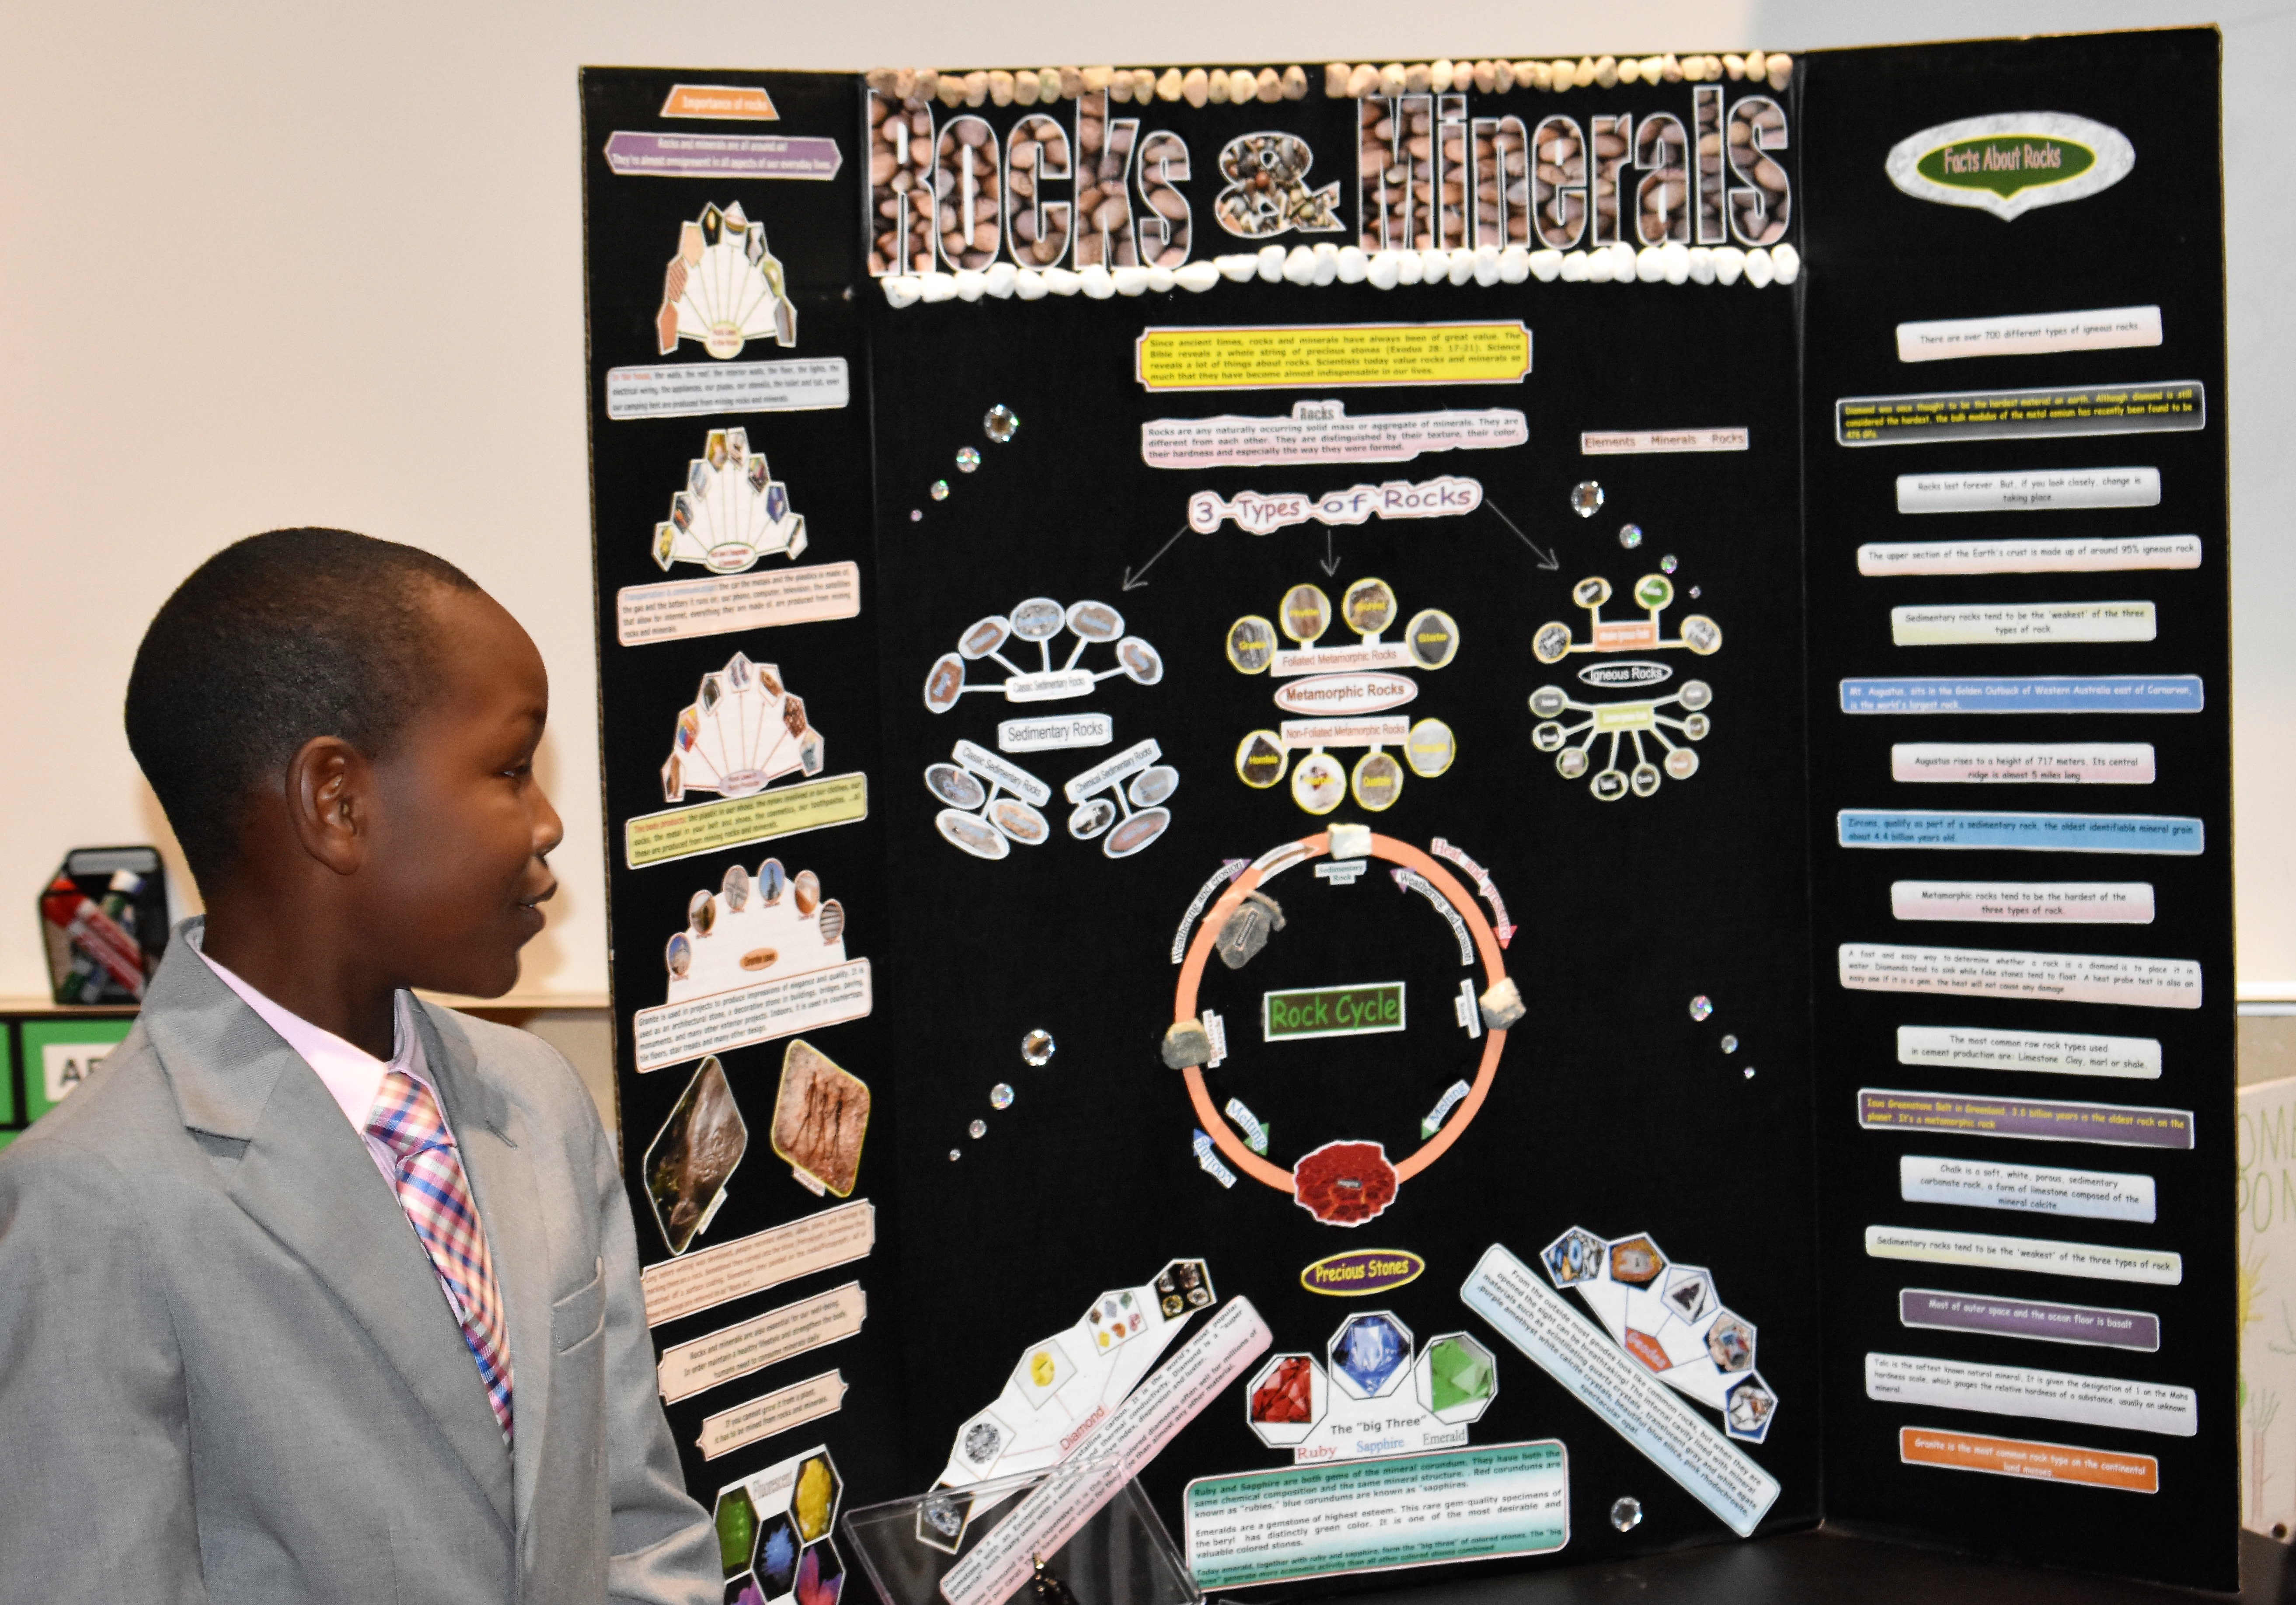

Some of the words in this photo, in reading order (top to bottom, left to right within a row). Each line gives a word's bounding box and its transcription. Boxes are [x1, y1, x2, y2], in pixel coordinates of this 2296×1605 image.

[1942, 147, 1980, 174] Facts
[1982, 145, 2022, 171] About
[2022, 141, 2061, 169] Rocks
[867, 85, 1192, 276] Rocks
[1214, 131, 1346, 238] &
[1358, 86, 1790, 253] Minerals
[1920, 335, 1944, 344] There
[1985, 331, 2000, 339] 700
[2003, 328, 2042, 338] different
[2045, 328, 2067, 338] types
[2070, 324, 2079, 334] of
[2083, 324, 2112, 335] igneous
[1300, 407, 1334, 420] Rocks
[1148, 428, 1174, 436] Rocks
[1215, 426, 1256, 434] naturally
[1259, 425, 1302, 433] occurring
[1371, 421, 1417, 431] aggregate
[1433, 419, 1474, 427] minerals.
[1479, 418, 1500, 426] They
[1148, 438, 1188, 447] different
[1217, 437, 1239, 445] each
[1275, 436, 1296, 444] They
[1320, 433, 1382, 443] distinguished
[1386, 432, 1397, 441] by
[1585, 436, 1635, 448] Elements
[1651, 434, 1696, 445] Minerals
[1712, 432, 1744, 444] Rocks
[1148, 450, 1170, 458] their
[1172, 449, 1214, 457] hardness
[1216, 448, 1233, 457] and
[1235, 447, 1280, 457] especially
[1282, 446, 1298, 454] the
[1321, 445, 1341, 454] they
[1196, 501, 1213, 523] 3
[1239, 500, 1300, 524] Types
[1324, 493, 1366, 513] of
[1385, 486, 1470, 508] Rocks
[1282, 655, 1315, 667] Foliated
[1317, 651, 1369, 664] Metamorphic
[1371, 649, 1397, 660] Rocks
[1013, 682, 1033, 693] Classic
[1034, 678, 1067, 691] Sedimentary
[1068, 677, 1085, 686] Rocks
[1590, 669, 1629, 681] Igneous
[1632, 667, 1662, 679] Rocks
[1286, 686, 1363, 701] Metamorphic
[1367, 683, 1404, 696] Rocks
[1008, 724, 1070, 742] Sedimentary
[1073, 721, 1103, 736] Rocks
[1286, 727, 1332, 739] Non-Foliated
[1335, 725, 1380, 736] Metamorphic
[1382, 723, 1405, 734] Rocks
[1075, 774, 1101, 793] Chemical
[1102, 758, 1134, 779] Sedimentary
[1134, 747, 1152, 761] Rocks
[1319, 864, 1362, 874] Sedimentary
[1434, 839, 1462, 861] Heat
[1465, 861, 1488, 880] and
[1482, 883, 1510, 936] pressure
[1921, 890, 1972, 901] Metamorphic
[1975, 892, 1997, 900] rocks
[2000, 892, 2019, 900] tend
[2047, 892, 2061, 901] the
[2064, 892, 2096, 901] hardest
[2099, 892, 2108, 901] of
[2112, 892, 2126, 901] the
[1171, 903, 1200, 962] Weathering
[1197, 884, 1212, 902] and
[1212, 860, 1243, 885] erosion
[1400, 872, 1446, 909] Weathering
[1445, 907, 1461, 924] and
[1456, 925, 1471, 961] erosion
[1981, 905, 2003, 914] three
[2007, 906, 2029, 917] types
[2032, 905, 2041, 915] of
[2044, 906, 2063, 914] rock
[1272, 995, 1328, 1028] Rock
[1336, 991, 1397, 1030] Cycle
[1430, 1083, 1465, 1121] Melting
[1228, 1101, 1267, 1149] Melting
[1195, 1138, 1231, 1184] Cooling
[1877, 1235, 1927, 1249] Sedimentary
[1929, 1241, 1951, 1250] rocks
[1954, 1243, 1972, 1252] tend
[1975, 1245, 1984, 1253] to
[1986, 1245, 1996, 1254] be
[2000, 1246, 2013, 1256] the
[2059, 1252, 2068, 1260] of
[2072, 1253, 2085, 1263] the
[2089, 1255, 2111, 1265] three
[2114, 1258, 2137, 1269] types
[2139, 1259, 2149, 1269] of
[1315, 1263, 1365, 1282] Precious
[1368, 1260, 1409, 1278] Stones
[1060, 1406, 1104, 1450] Diamond
[1297, 1446, 1337, 1459] Ruby
[1357, 1438, 1404, 1454] Sapphire
[1423, 1429, 1465, 1445] Emerald
[1195, 1525, 1237, 1537] Emeralds
[1266, 1518, 1310, 1530] gemstone
[1312, 1514, 1321, 1523] of
[1324, 1511, 1358, 1522] highest
[1502, 1491, 1549, 1503] specimens
[1552, 1490, 1561, 1498] of
